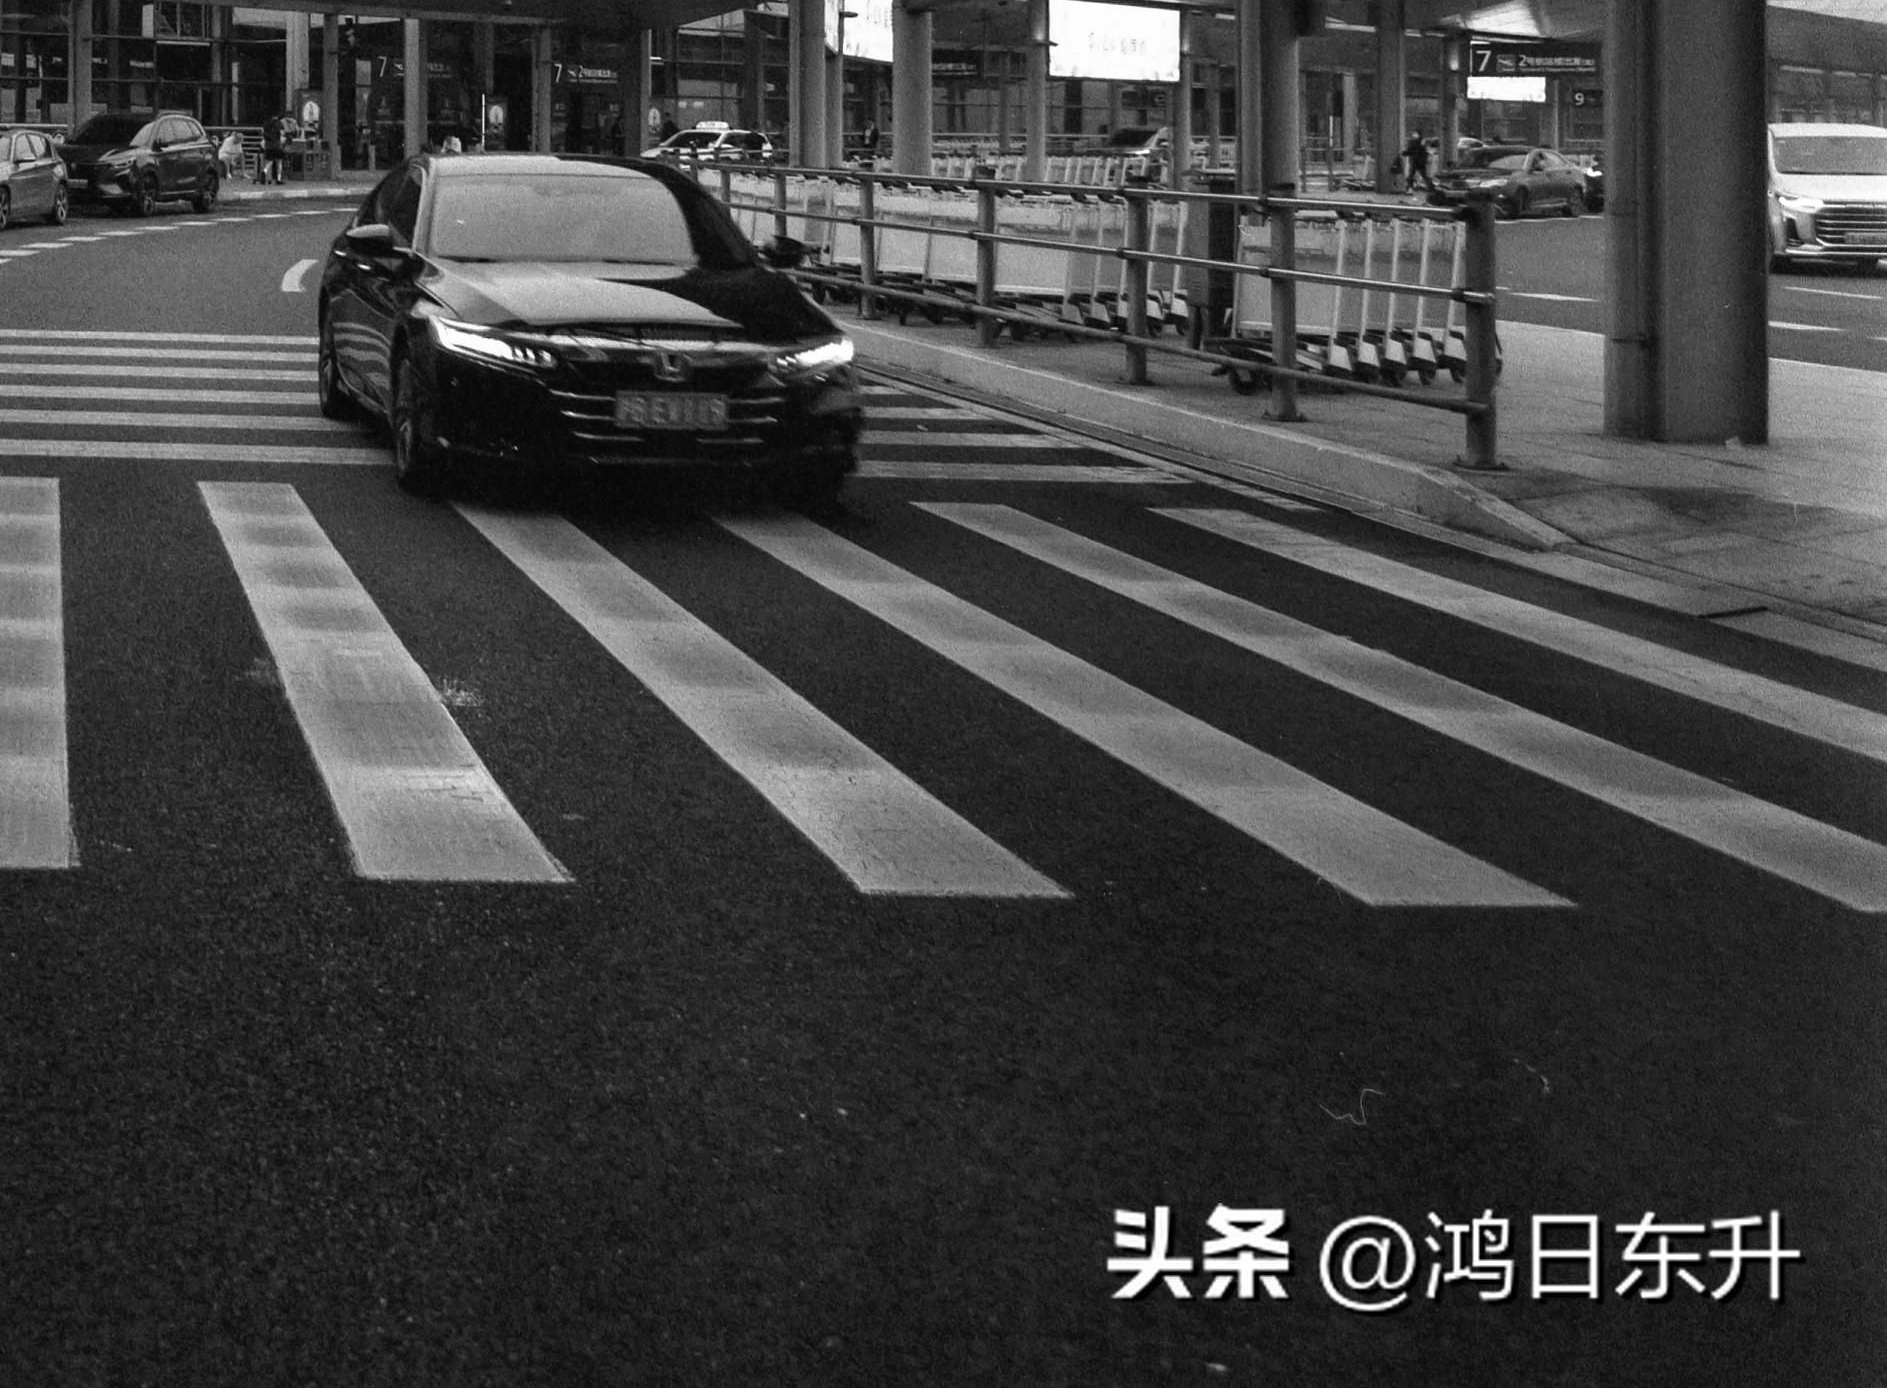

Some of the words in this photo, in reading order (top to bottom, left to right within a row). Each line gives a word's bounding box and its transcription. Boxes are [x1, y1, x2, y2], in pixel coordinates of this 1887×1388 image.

[378, 55, 387, 78] 7
[1475, 50, 1492, 72] 7
[554, 62, 563, 84] 7
[1574, 92, 1585, 106] 9
